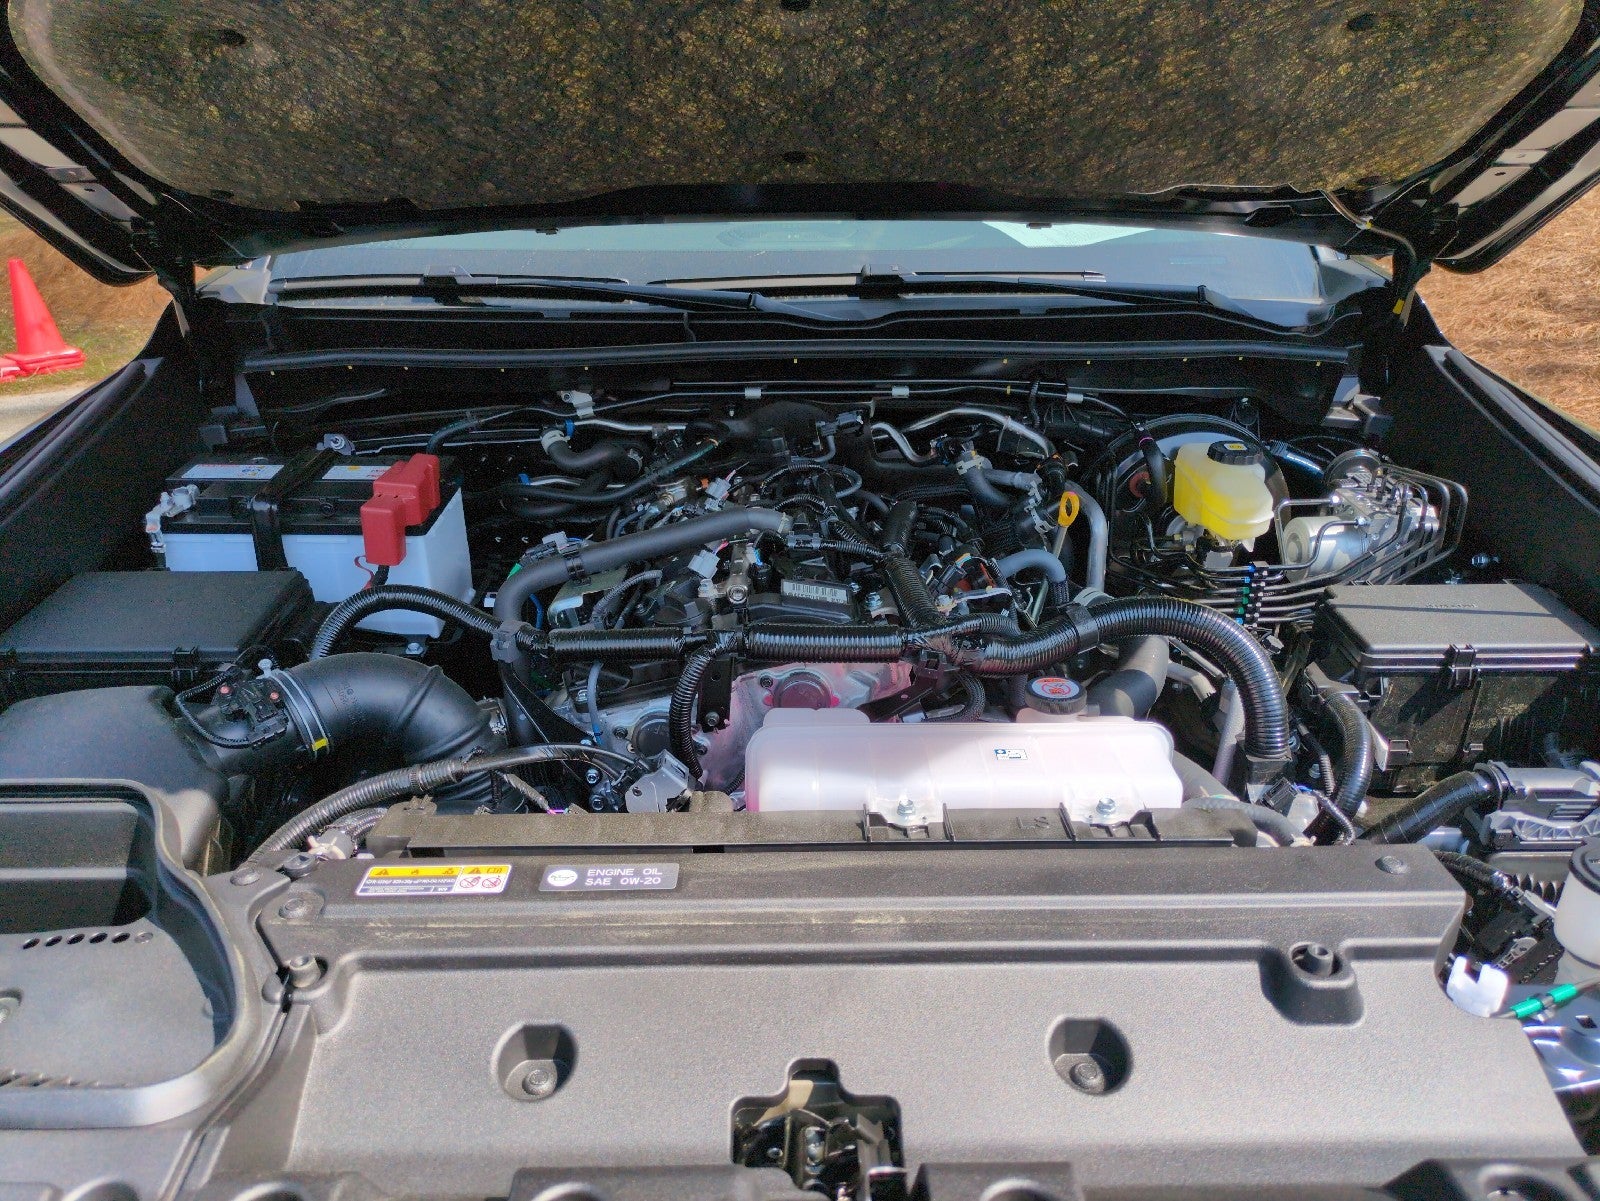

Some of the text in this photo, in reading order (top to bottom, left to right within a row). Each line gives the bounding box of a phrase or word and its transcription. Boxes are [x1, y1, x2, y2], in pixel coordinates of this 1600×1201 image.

[587, 868, 662, 876] ENGINE OIL
[585, 877, 661, 886] SAE 0W-20
